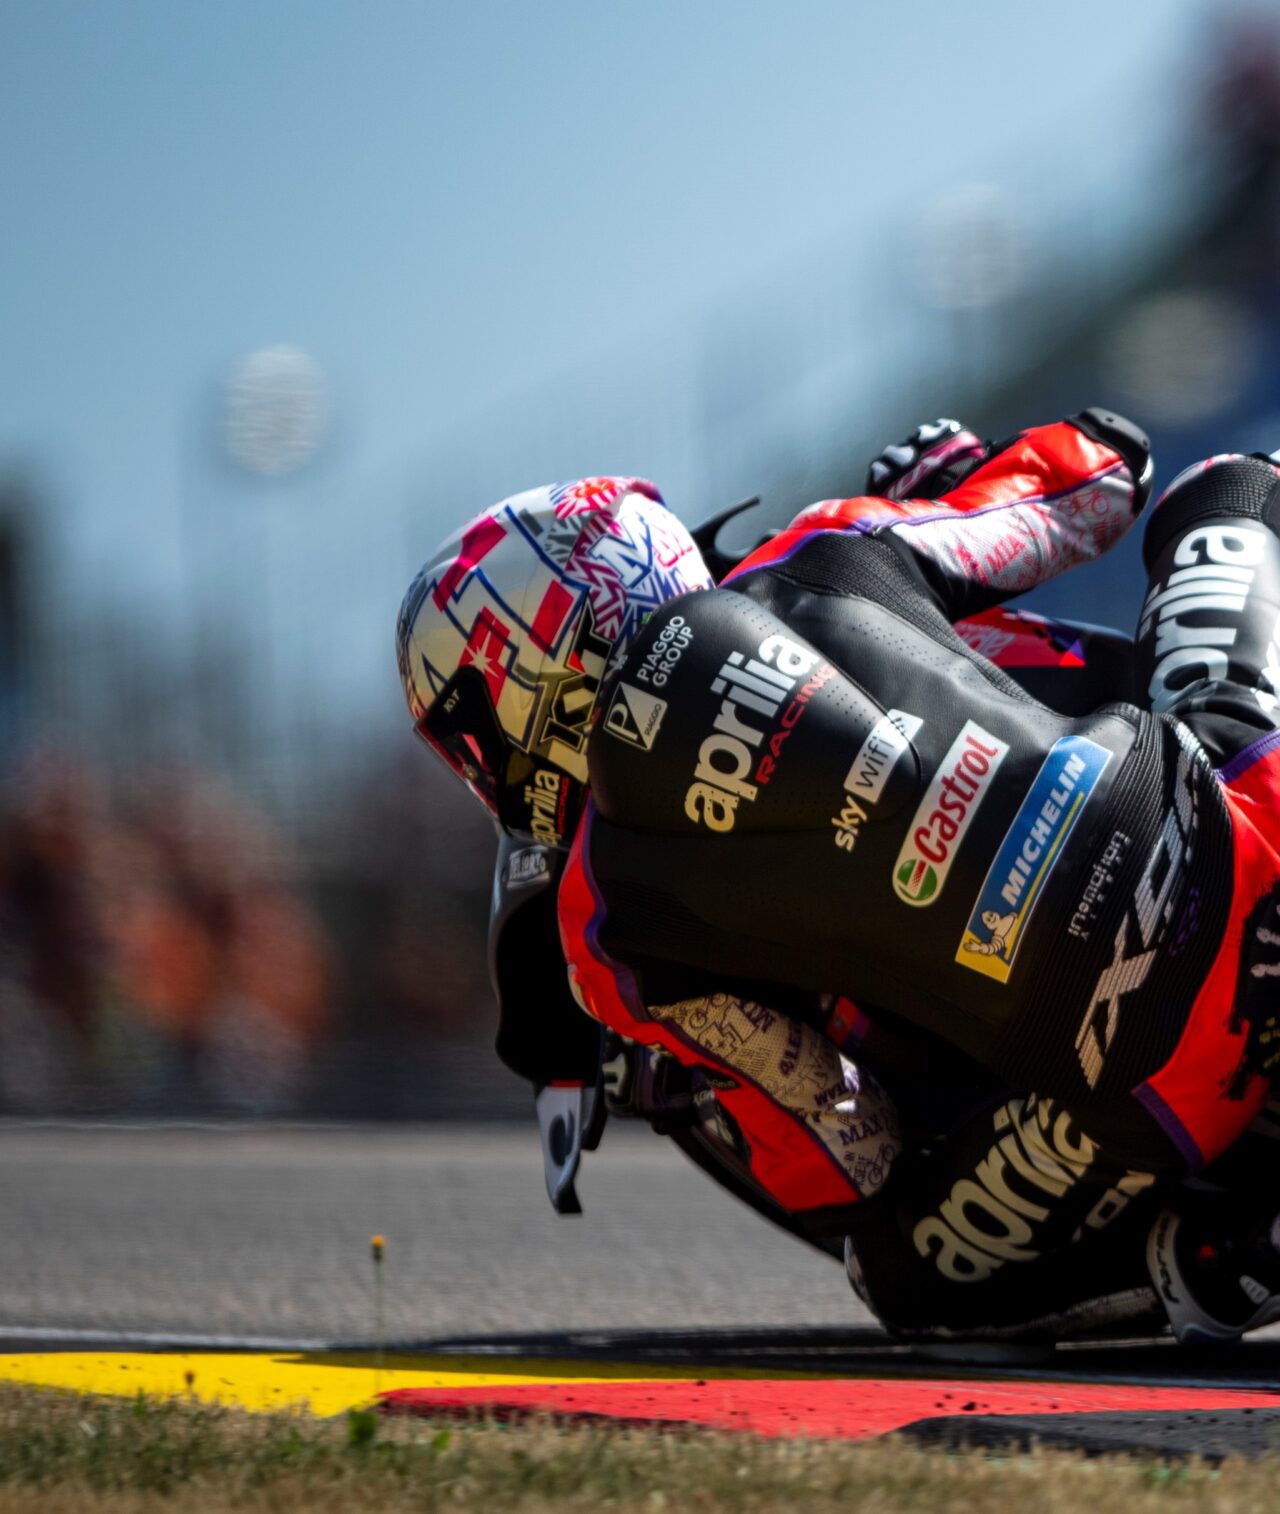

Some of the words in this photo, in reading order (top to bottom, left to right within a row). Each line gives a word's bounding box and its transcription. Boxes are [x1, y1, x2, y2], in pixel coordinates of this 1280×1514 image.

[637, 615, 685, 681] PIAGGIO
[652, 626, 694, 687] GROUP
[1139, 525, 1266, 712] prilia
[684, 634, 819, 833] aprilia
[756, 662, 838, 784] RACING
[523, 768, 561, 848] aprilia
[830, 795, 867, 853] sky
[855, 731, 890, 788] wifi
[914, 733, 999, 865] Castrol
[1000, 752, 1087, 908] MICHELIN
[838, 1114, 882, 1146] MAX
